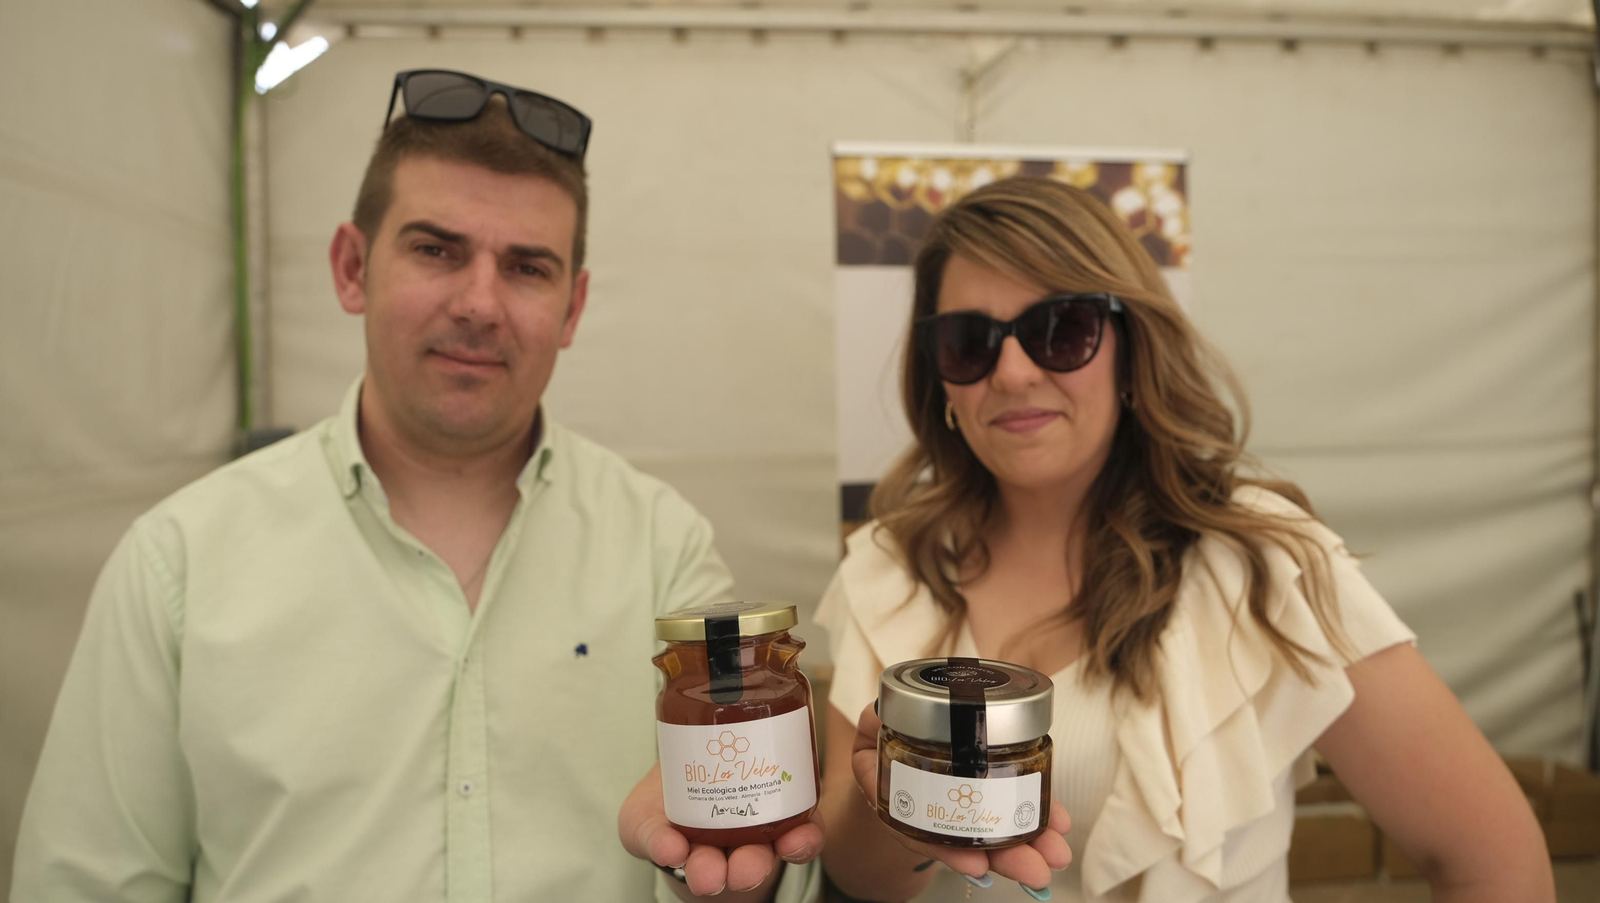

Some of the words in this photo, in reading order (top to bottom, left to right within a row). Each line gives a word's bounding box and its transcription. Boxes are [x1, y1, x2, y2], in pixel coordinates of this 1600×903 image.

[687, 786, 700, 794] Miel
[701, 786, 737, 795] Ecológica
[738, 785, 748, 793] de
[750, 779, 782, 790] Montaña
[764, 787, 781, 796] España
[933, 822, 993, 833] ECODELICATESSEN
